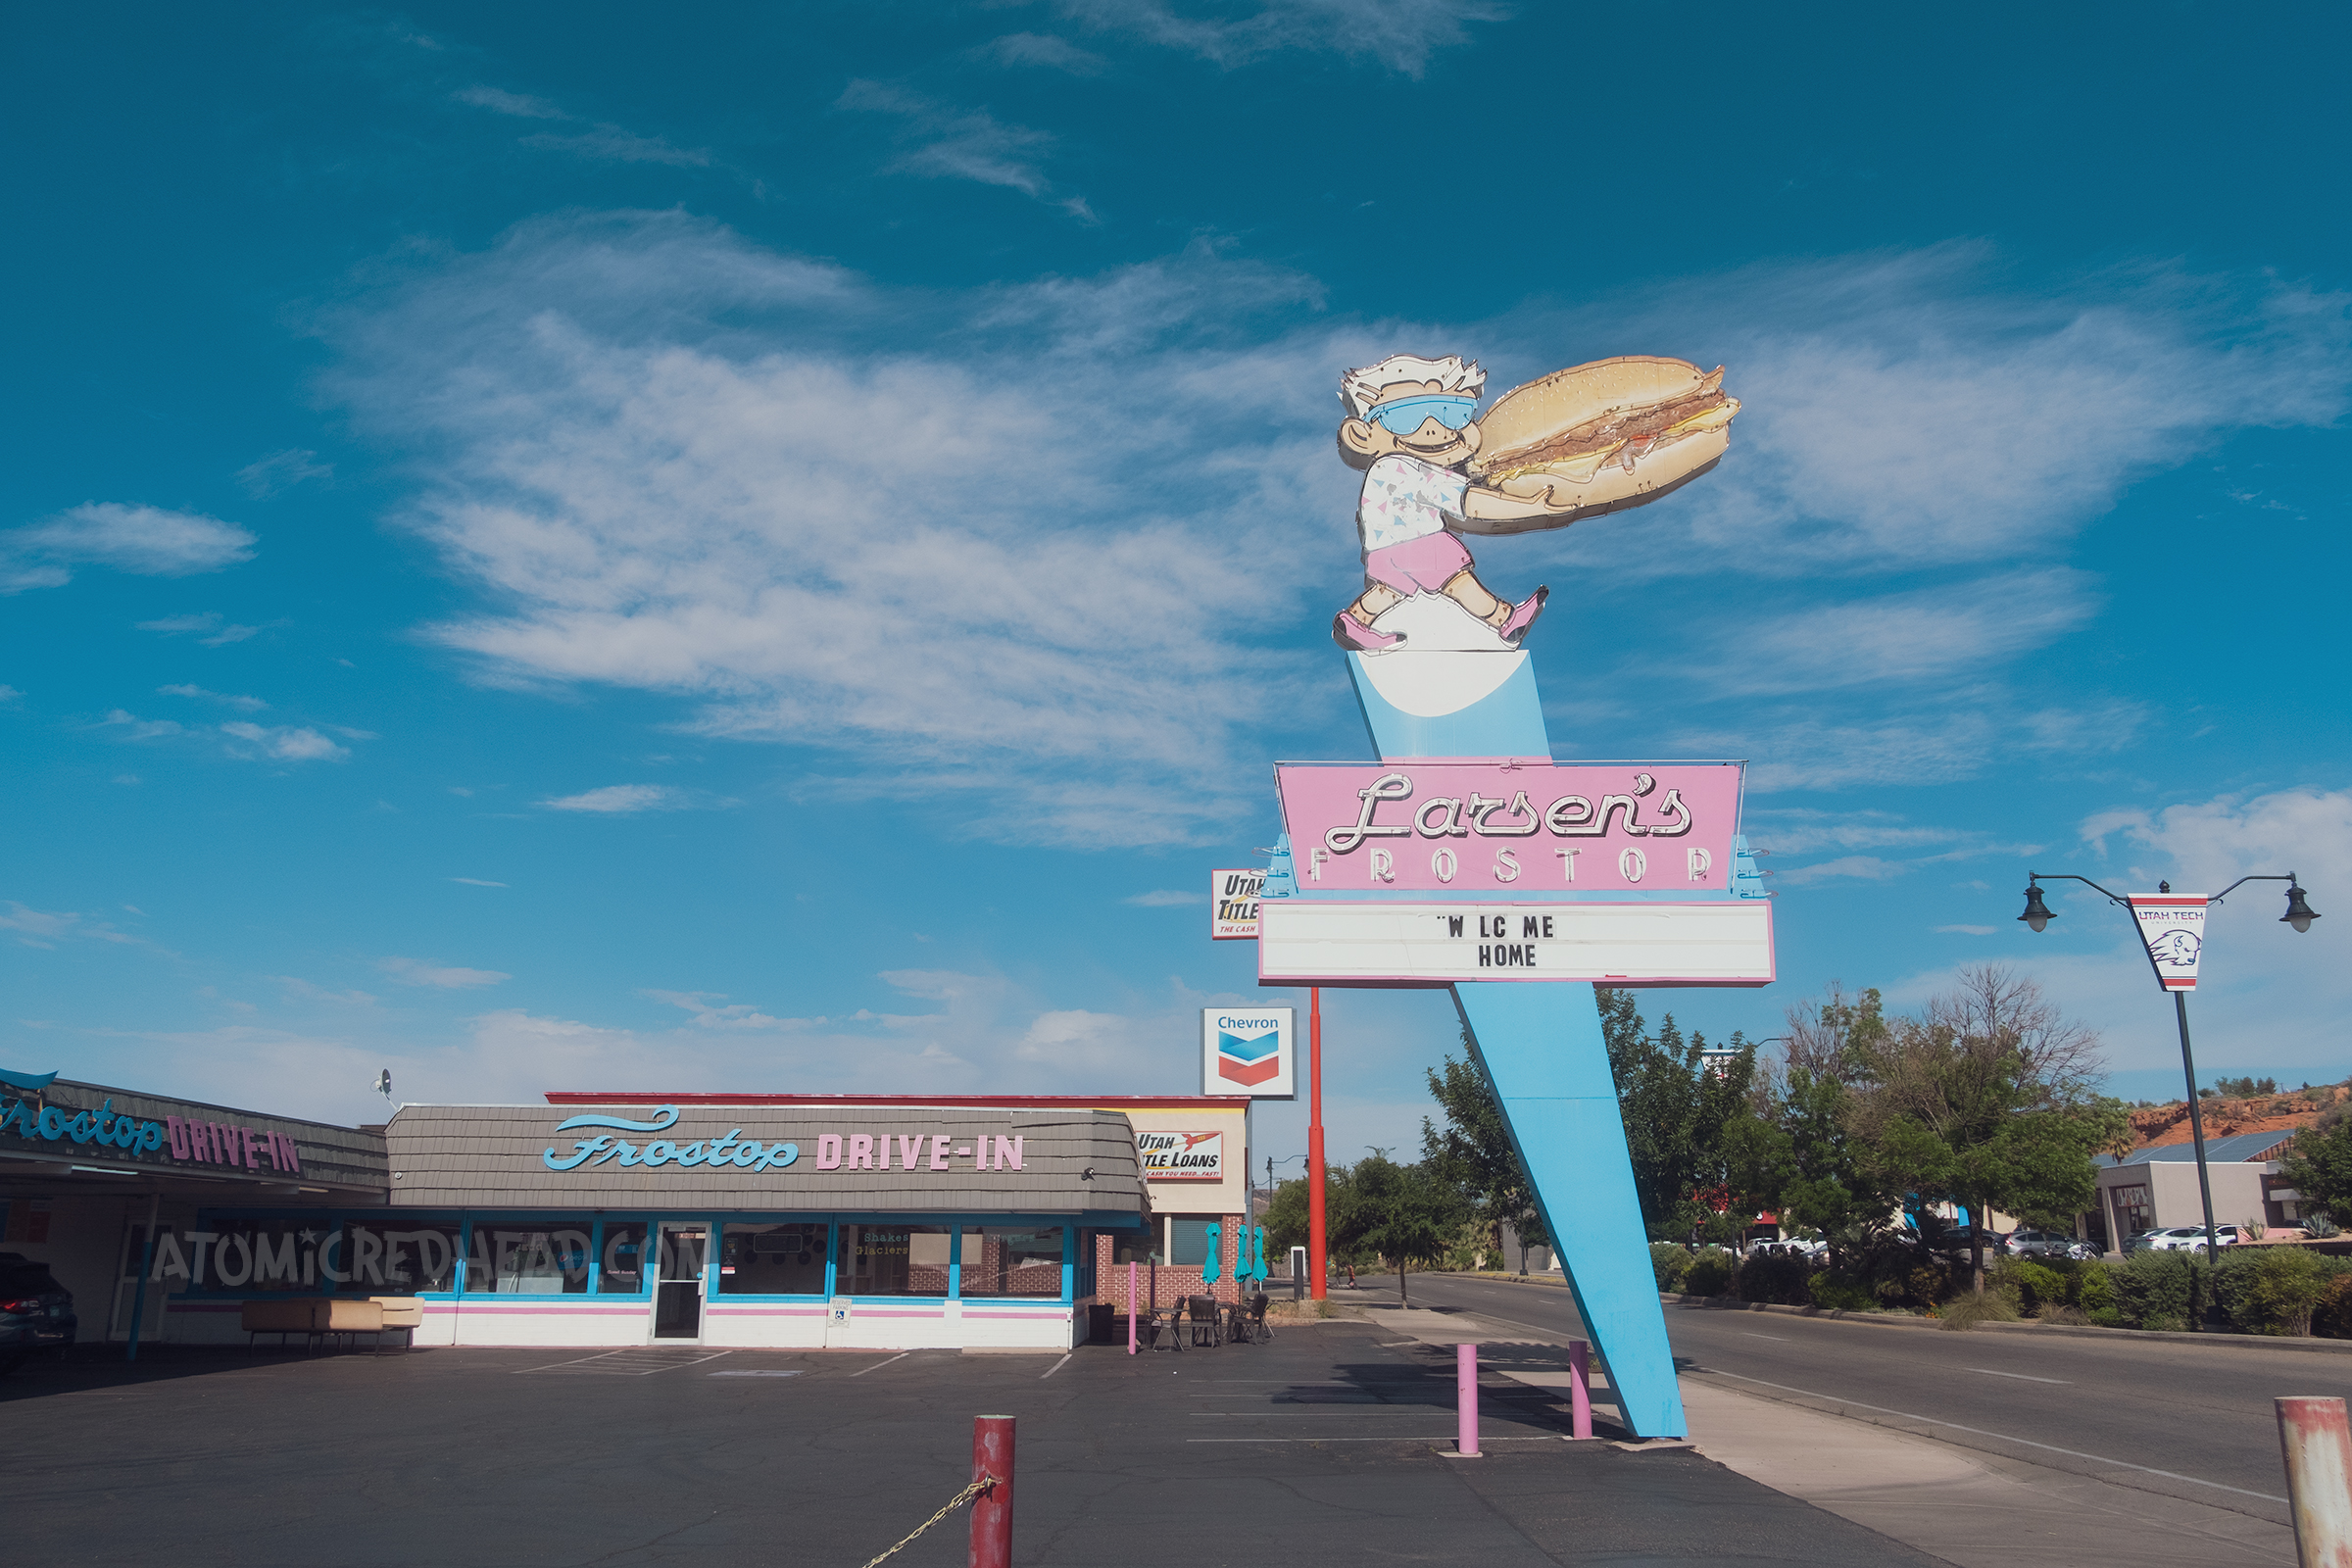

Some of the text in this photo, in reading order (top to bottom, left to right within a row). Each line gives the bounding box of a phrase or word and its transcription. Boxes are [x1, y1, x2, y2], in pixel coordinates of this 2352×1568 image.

[1325, 772, 1691, 854] Larsen's
[1307, 847, 1713, 883] FROSTOP
[1218, 899, 1259, 920] TITLE
[2138, 911, 2204, 920] UTAH TECH
[1478, 945, 1537, 967] HOME
[1218, 1016, 1279, 1029] Chevron
[167, 1115, 300, 1173] DRIVE-IN
[544, 1104, 1024, 1172] Frostop DRIVE-IN
[1138, 1134, 1175, 1150] UTAH
[1171, 1152, 1219, 1167] LOANS
[863, 1232, 908, 1243] Shakes
[855, 1246, 909, 1255] Glaciers
